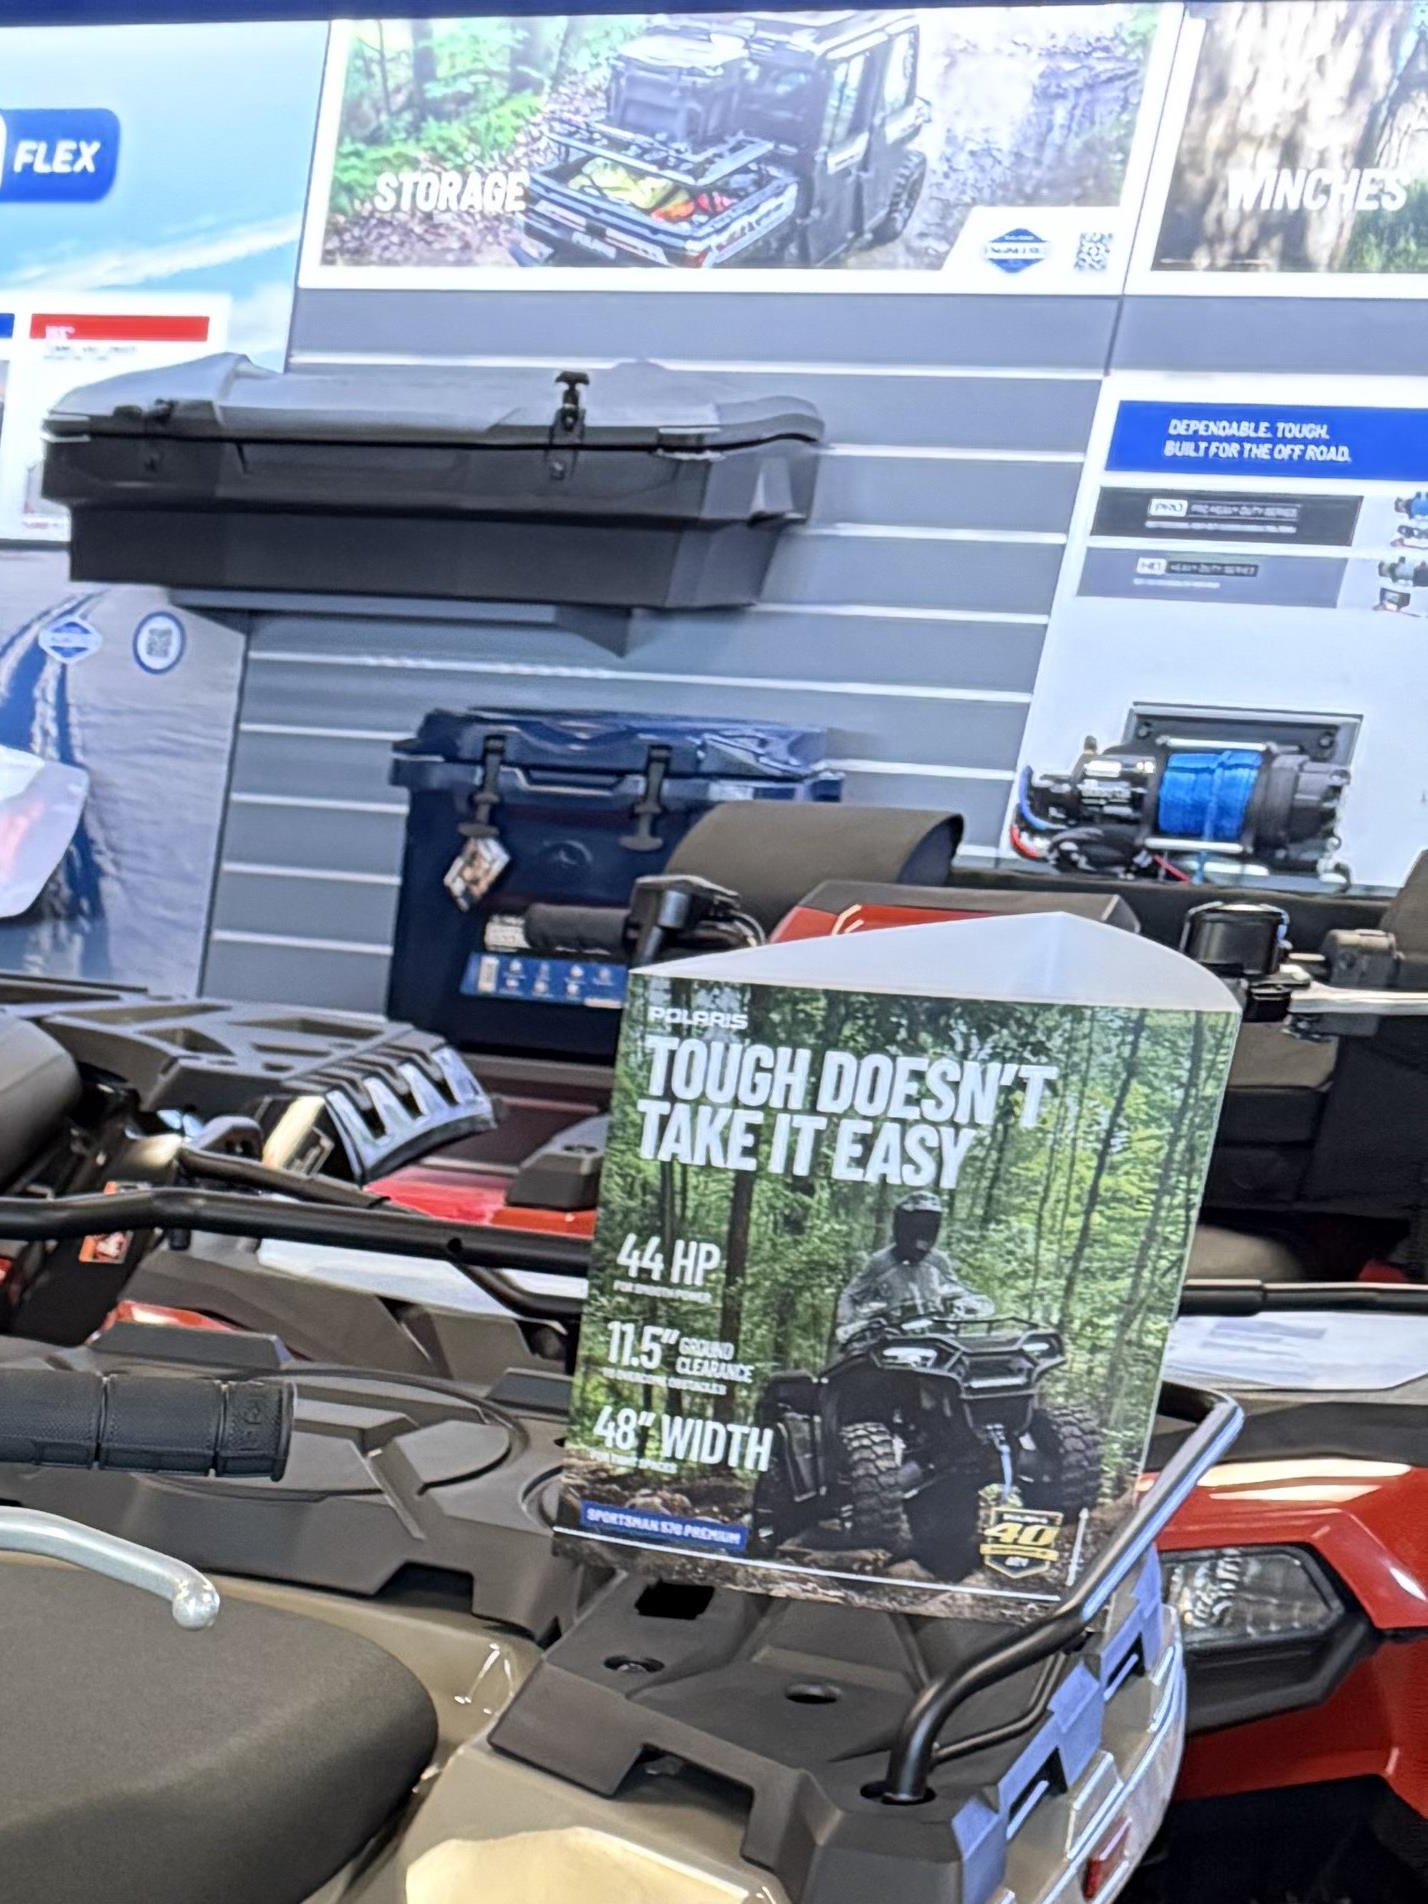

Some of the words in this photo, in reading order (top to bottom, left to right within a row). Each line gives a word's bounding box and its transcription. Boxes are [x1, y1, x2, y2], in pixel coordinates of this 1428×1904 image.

[13, 140, 101, 174] FLEX
[375, 170, 529, 213] STORAGE
[1229, 169, 1410, 212] WINCHES
[1168, 419, 1272, 438] DEPENDABLE.
[1276, 422, 1330, 440] TOUGH.
[1163, 440, 1208, 457] BUILT
[1209, 441, 1241, 458] FOR
[1242, 442, 1272, 459] THE
[1274, 444, 1304, 461] OFF
[1305, 445, 1352, 463] ROAD.
[648, 1006, 749, 1030] POLARIS
[643, 1035, 812, 1110] TOUGH
[816, 1050, 1059, 1128] DOESN'T
[638, 1098, 764, 1172] TAKE
[769, 1113, 828, 1177] IT
[831, 1118, 977, 1189] EASY
[616, 1233, 665, 1281] 44
[670, 1239, 722, 1287] HP
[678, 1337, 735, 1360] GROUND
[675, 1356, 755, 1383] CLEARANCE
[594, 1405, 656, 1451] 48"
[660, 1413, 774, 1472] WIDTH
[587, 1508, 659, 1533] SPORTSMAN
[683, 1524, 742, 1546] PREMIUM
[984, 1522, 1060, 1546] 40
